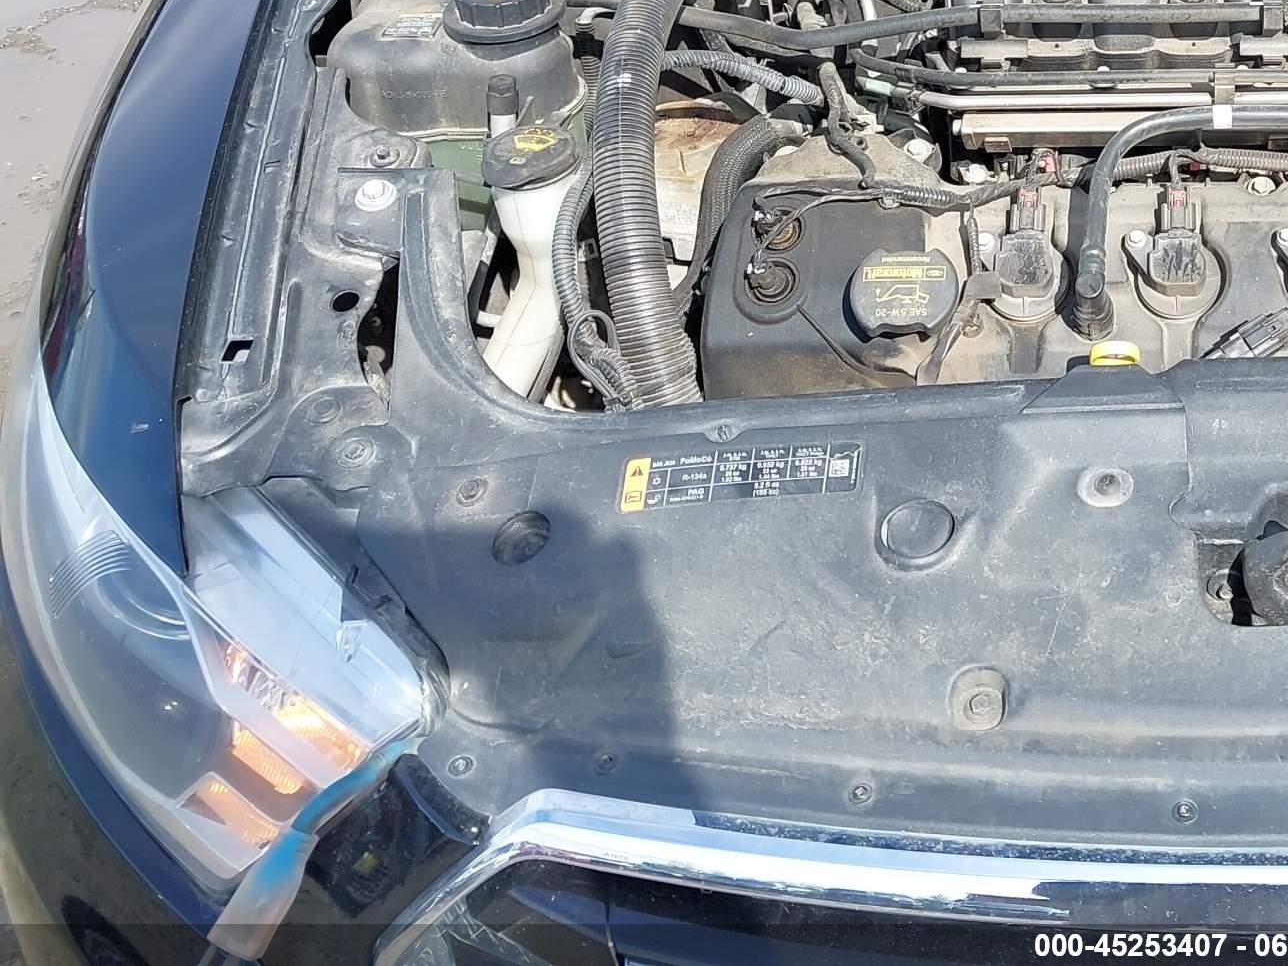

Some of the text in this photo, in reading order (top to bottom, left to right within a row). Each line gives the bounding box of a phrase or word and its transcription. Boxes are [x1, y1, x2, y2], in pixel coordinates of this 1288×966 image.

[864, 267, 924, 280] Motorcraft
[909, 307, 928, 316] SAE
[687, 487, 705, 496] PAG
